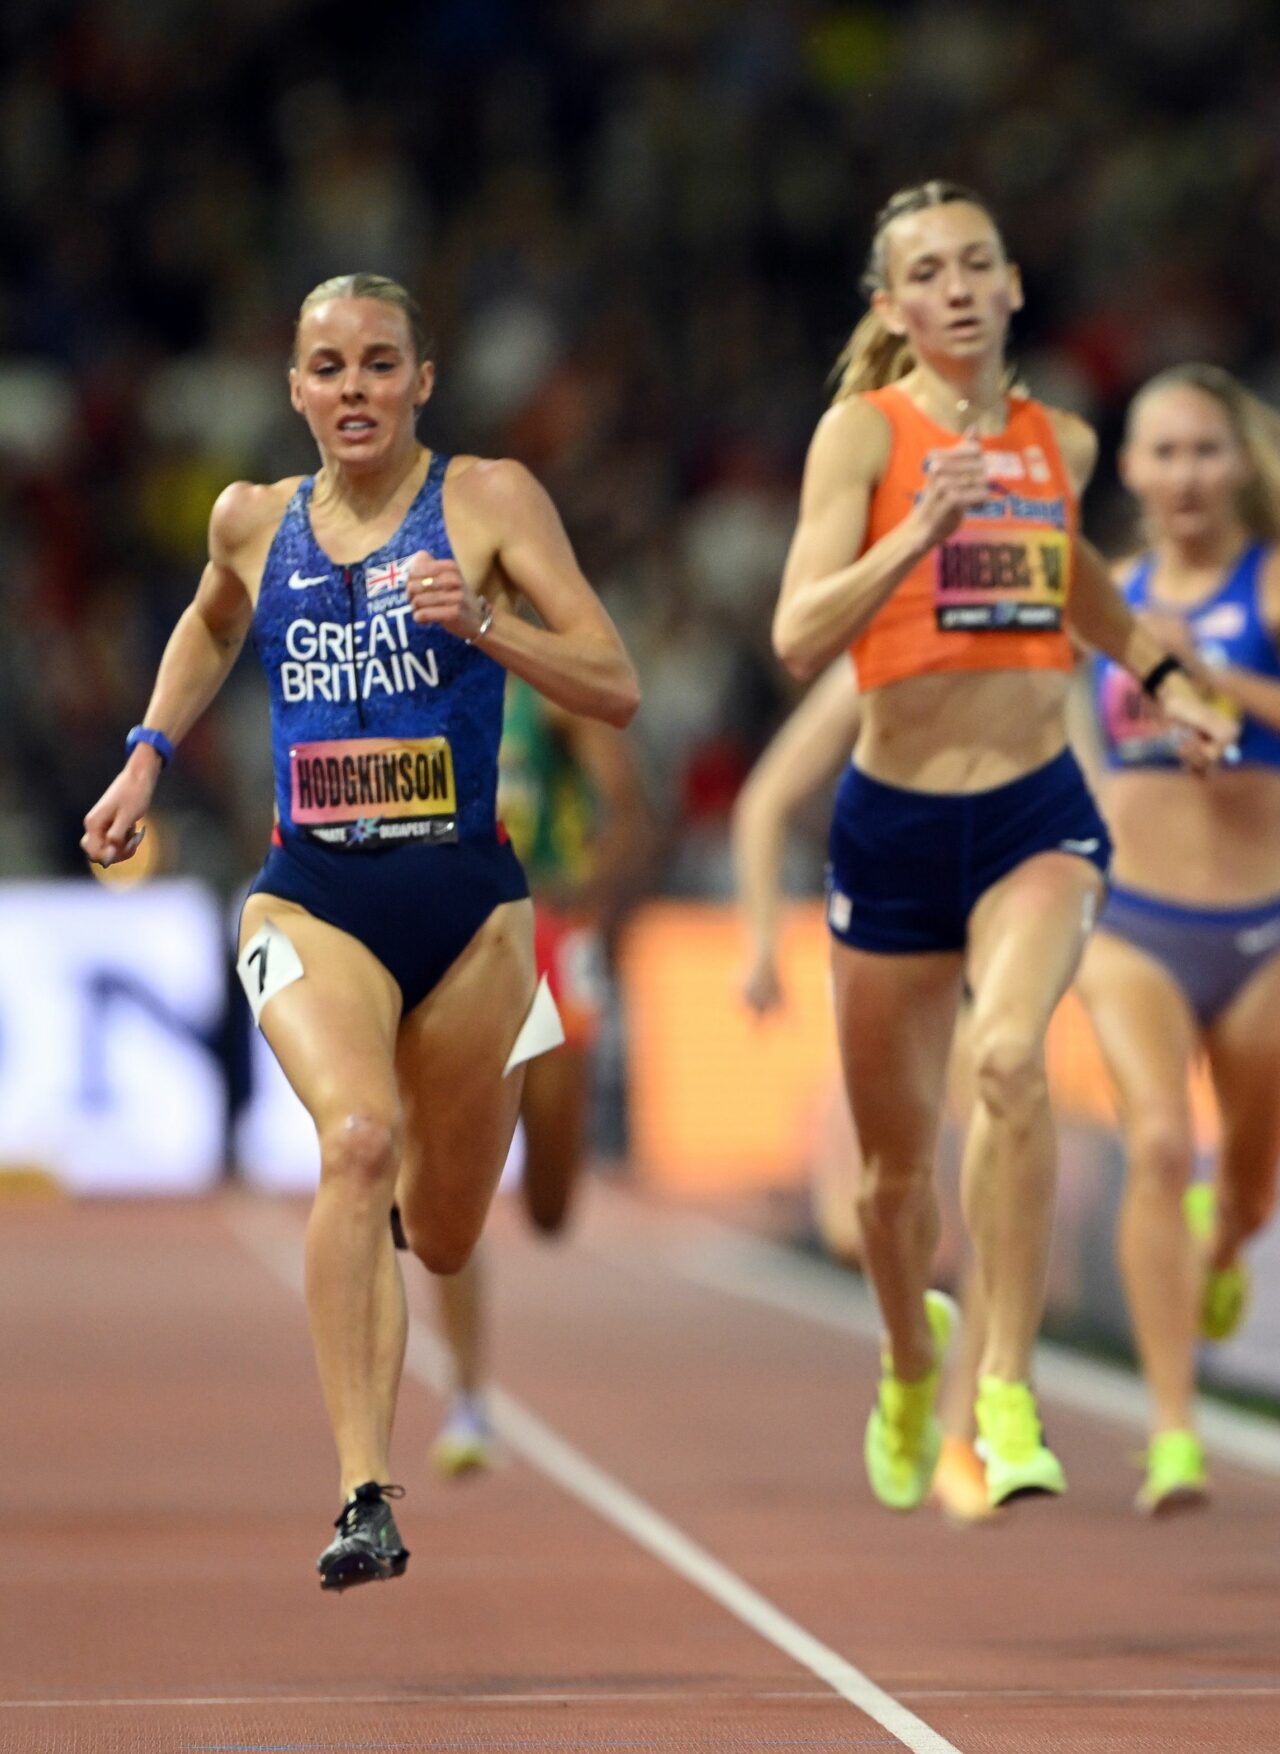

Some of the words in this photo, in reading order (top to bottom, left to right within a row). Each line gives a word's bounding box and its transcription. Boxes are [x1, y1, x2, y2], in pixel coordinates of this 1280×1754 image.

[286, 604, 415, 662] GREAT
[280, 648, 440, 702] BRITAIN
[297, 751, 448, 809] HODGKINSON
